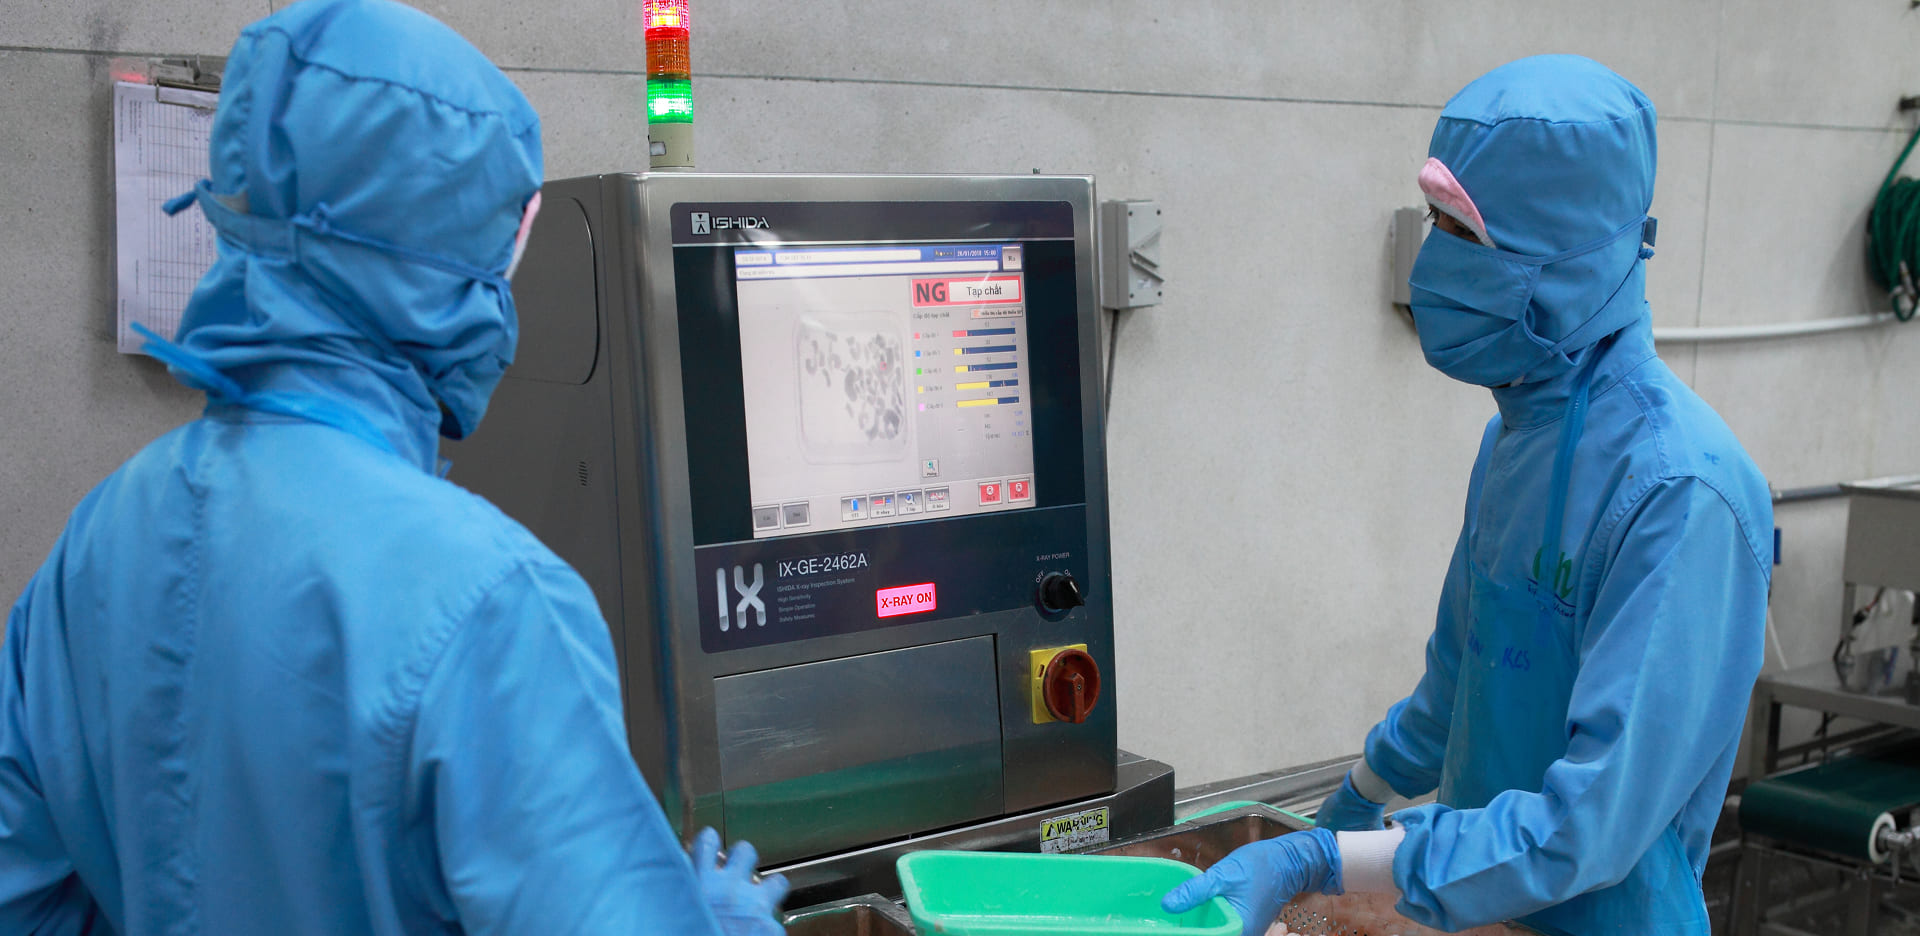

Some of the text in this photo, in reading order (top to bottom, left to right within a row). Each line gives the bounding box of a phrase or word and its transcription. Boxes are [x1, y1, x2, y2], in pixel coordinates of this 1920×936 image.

[712, 217, 769, 229] ISHIDA
[916, 282, 946, 302] NG
[984, 283, 1002, 296] chất
[1051, 552, 1070, 560] POWER
[778, 553, 868, 578] IX-GE-2462A
[796, 583, 810, 591] X-ray
[810, 580, 837, 589] Inspection
[837, 577, 856, 585] System
[716, 563, 767, 632] IX
[881, 591, 932, 609] X-RAY ON
